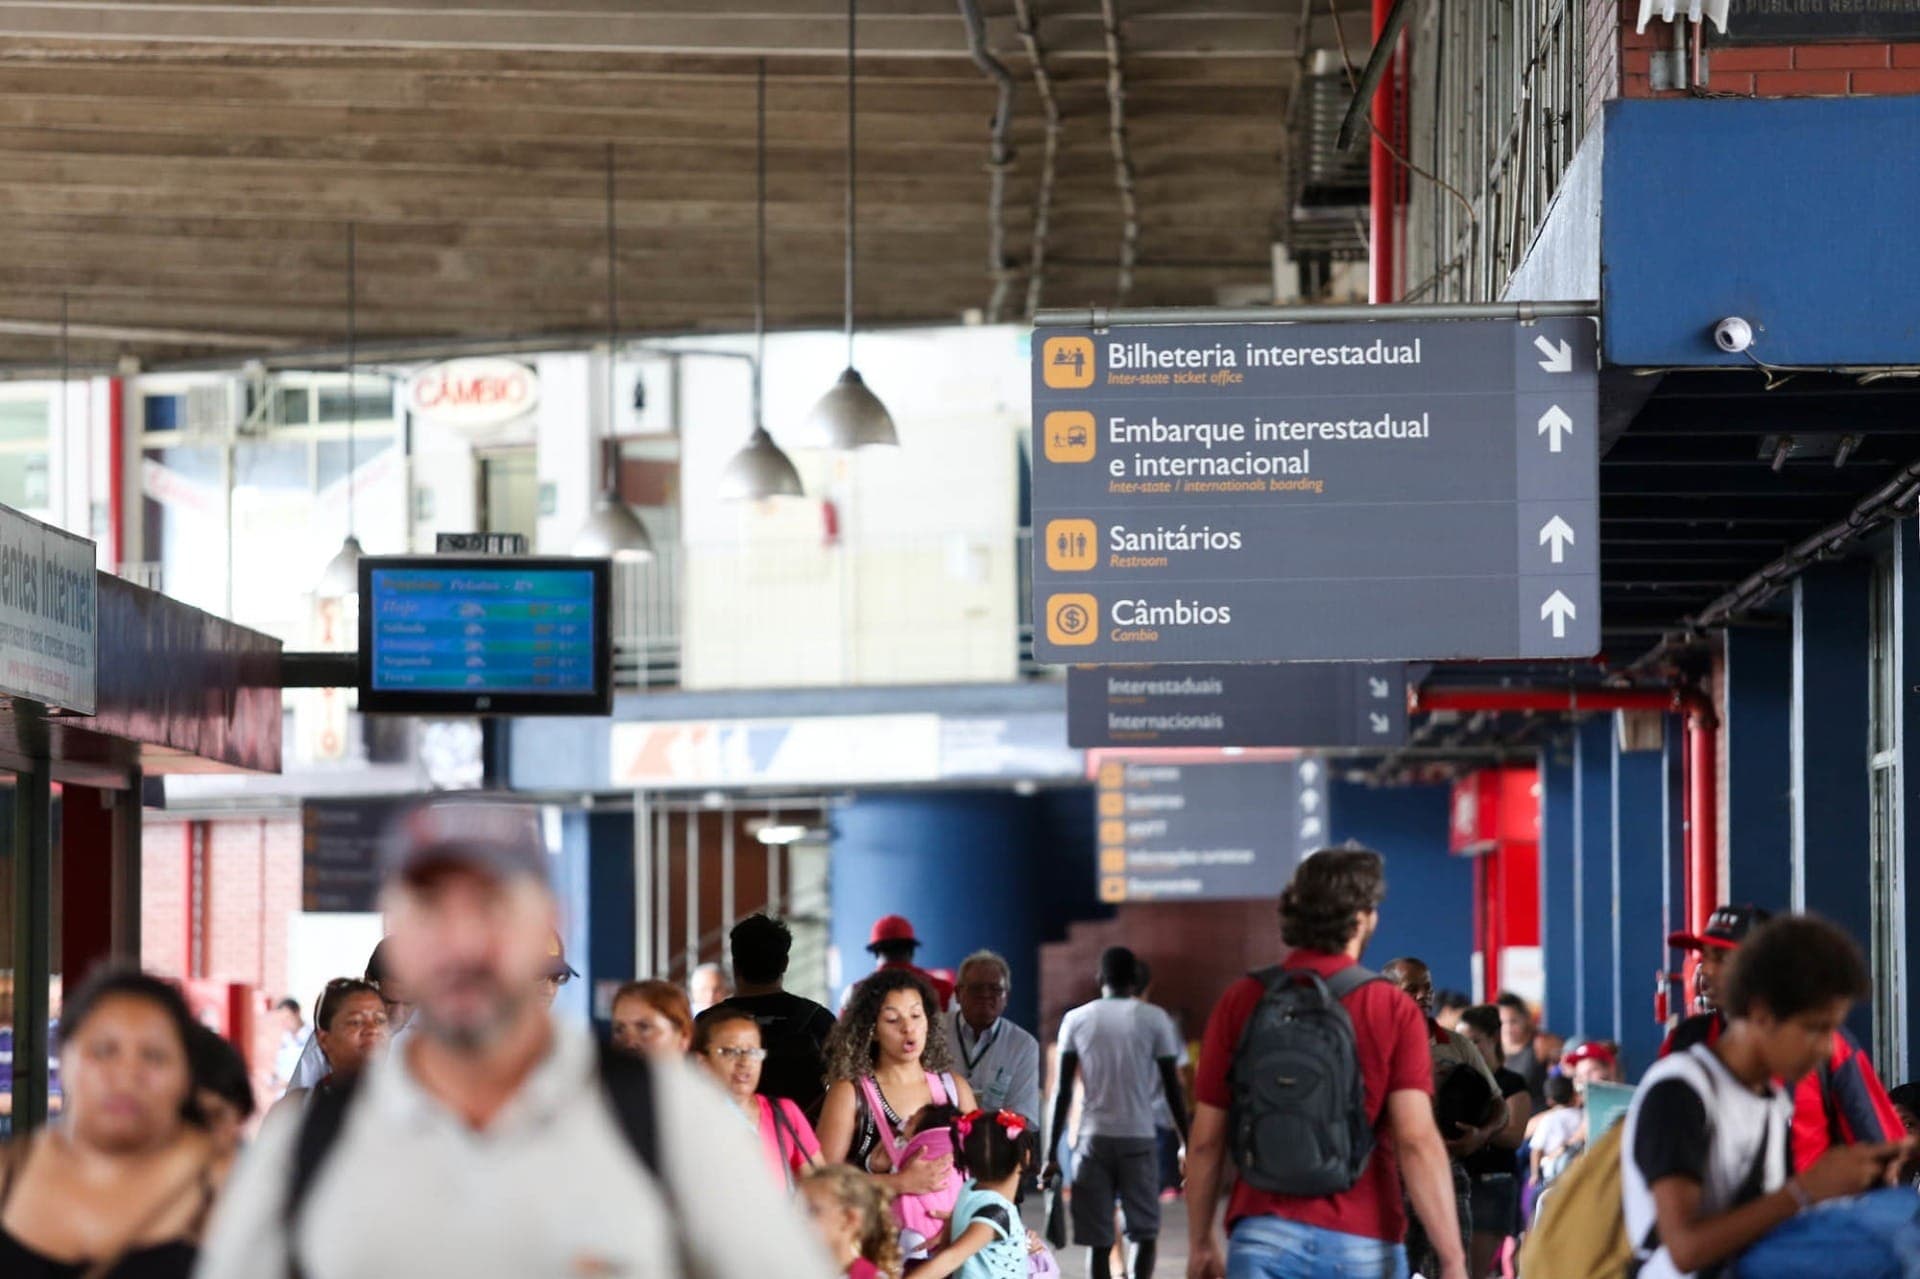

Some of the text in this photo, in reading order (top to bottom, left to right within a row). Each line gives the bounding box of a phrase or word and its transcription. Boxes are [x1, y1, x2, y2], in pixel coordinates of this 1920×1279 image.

[1108, 338, 1421, 368] Bilheteria interestadual
[1107, 370, 1243, 386] Inter-state ticket office
[1110, 412, 1429, 449] Embarque interestadual
[1109, 449, 1309, 476] e internacional
[1109, 480, 1171, 493] Inter-state
[1184, 479, 1265, 492] internationals
[1271, 478, 1323, 493] boarding
[1110, 524, 1242, 551] Sanitários
[1110, 555, 1167, 568] Restroom
[42, 540, 91, 633] Internet
[1111, 599, 1231, 626] Câmbios
[1111, 628, 1158, 642] Cambio
[1108, 677, 1223, 695] Interestaduais
[1108, 712, 1223, 729] Internacionais
